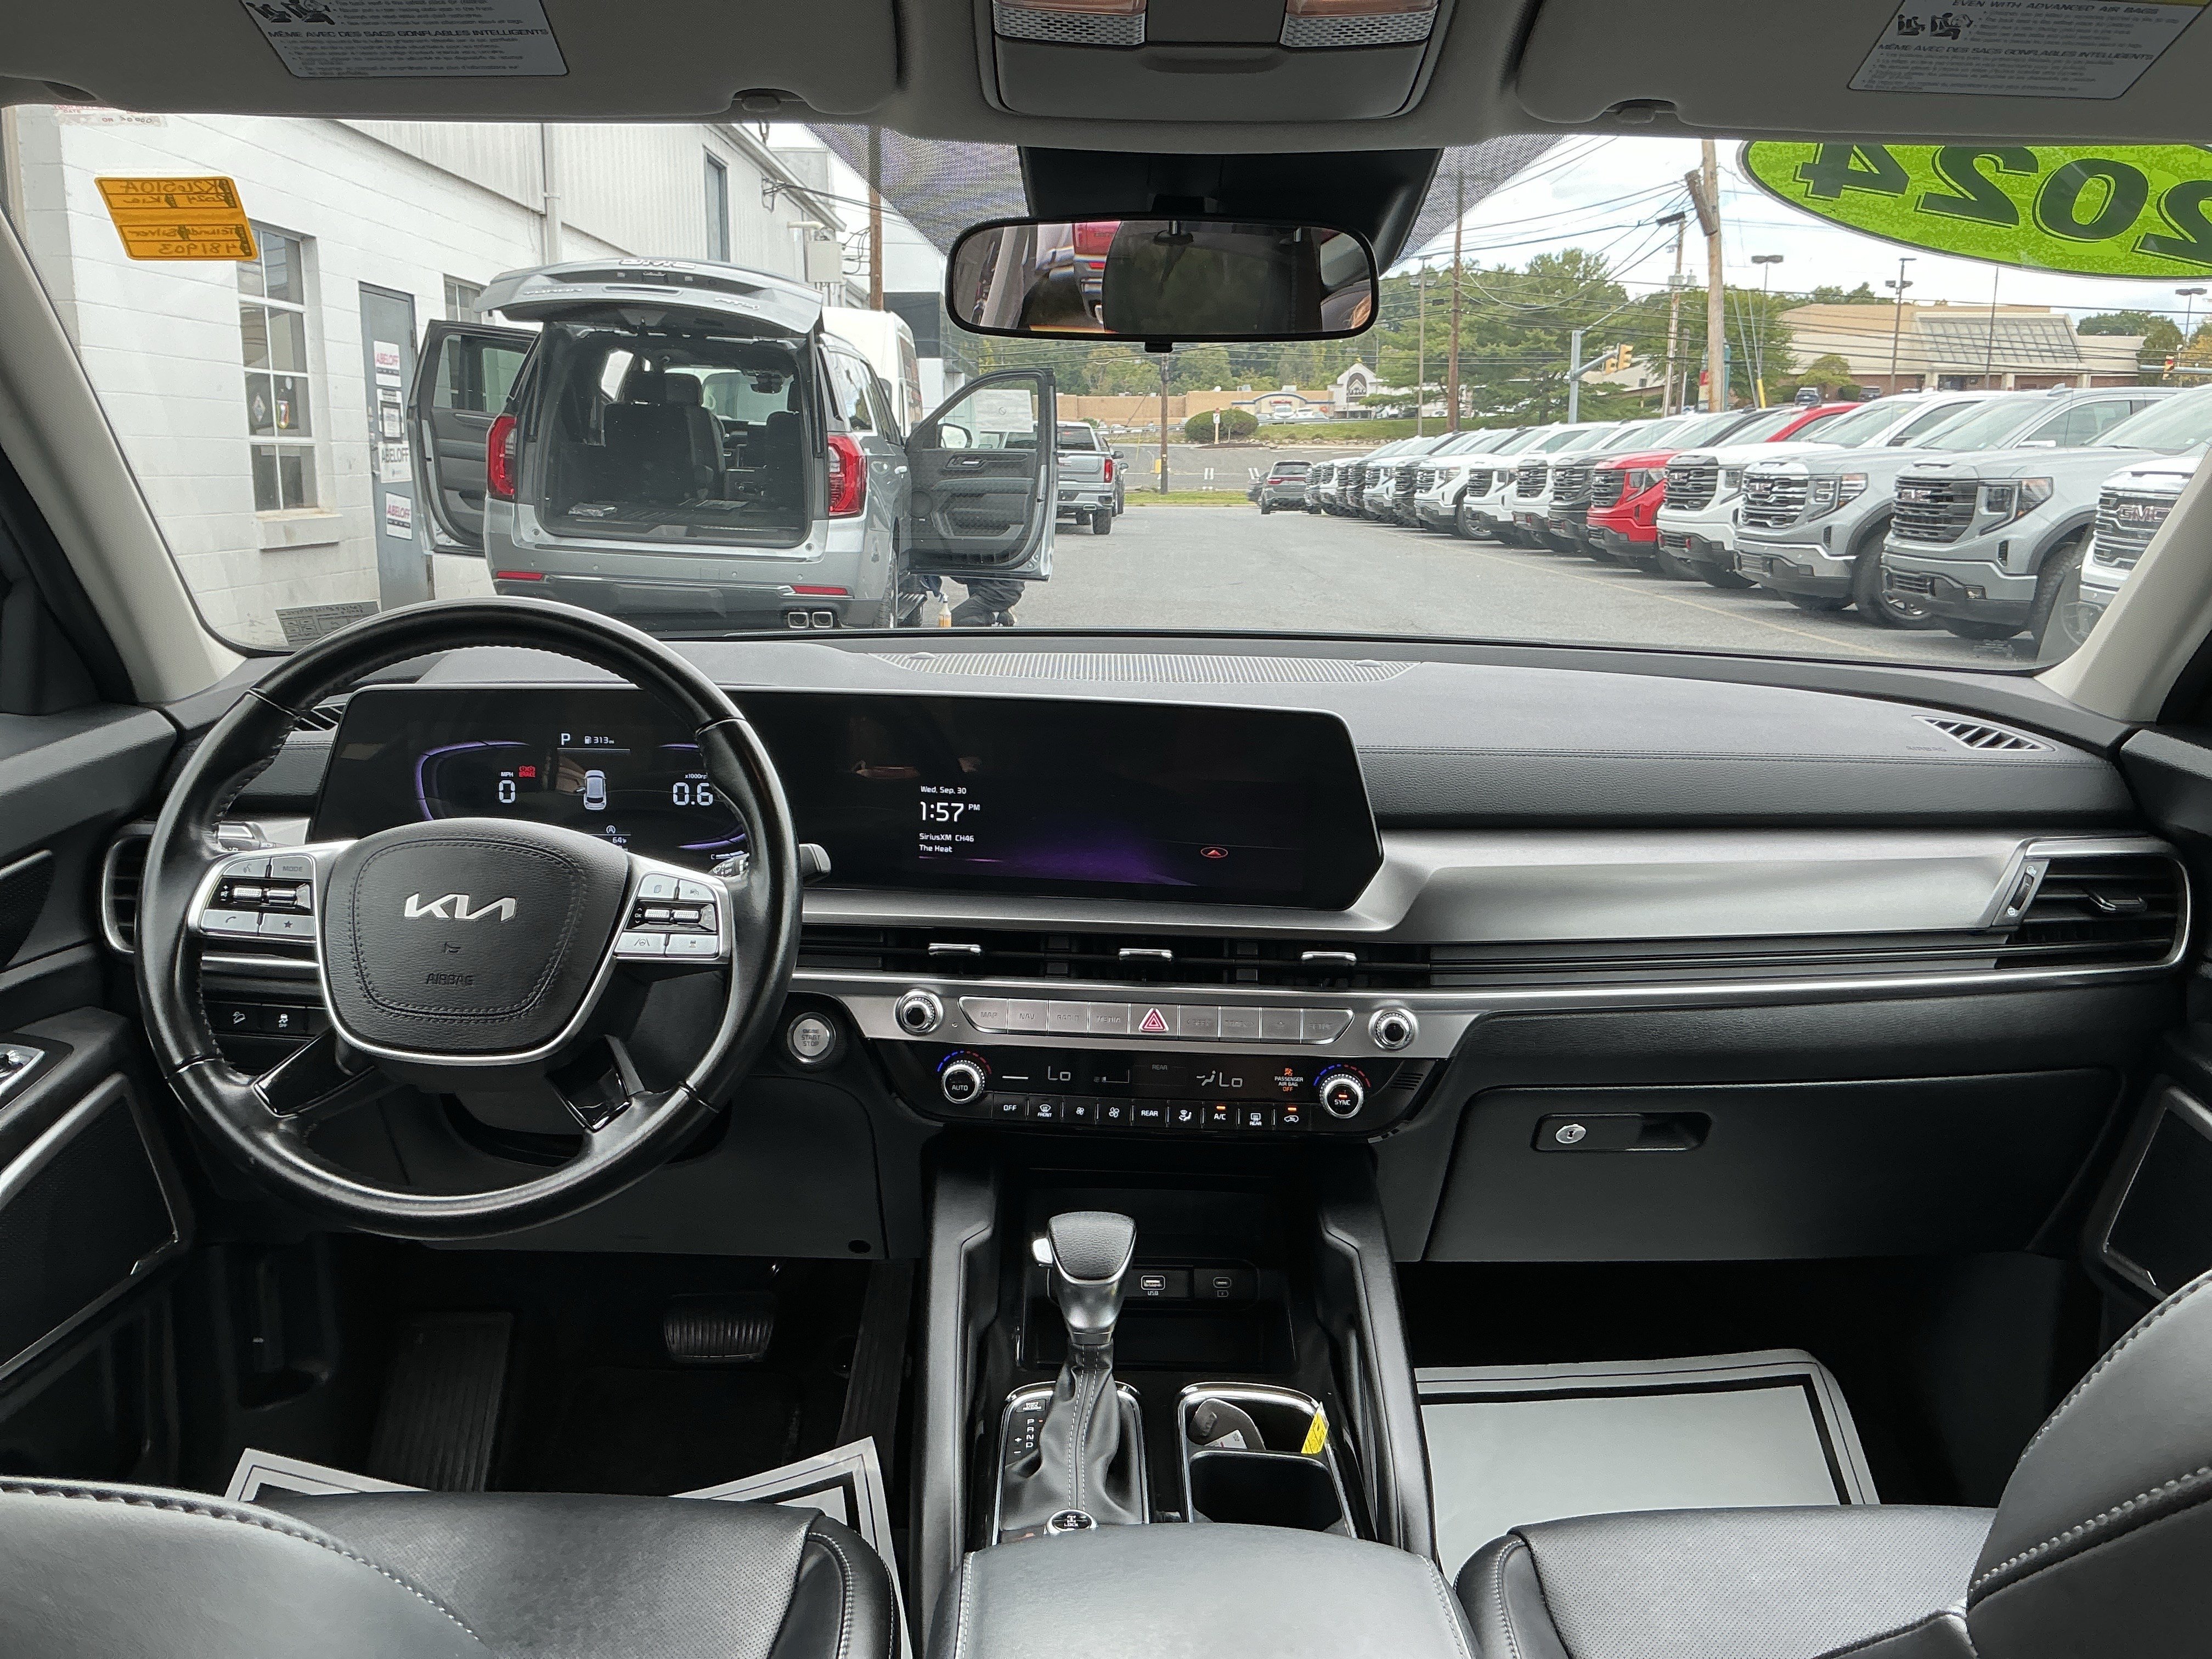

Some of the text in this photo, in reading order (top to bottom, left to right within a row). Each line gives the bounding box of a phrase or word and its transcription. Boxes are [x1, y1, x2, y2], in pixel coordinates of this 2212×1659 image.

[382, 447, 409, 463] ABELOFF
[387, 504, 410, 520] ABELOFF
[2119, 504, 2172, 522] GMC
[561, 733, 571, 746] P
[499, 780, 516, 803] 0
[673, 782, 713, 806] 0.6
[939, 786, 956, 794] Sep.
[920, 801, 964, 822] 1:57
[404, 893, 517, 922] KIA
